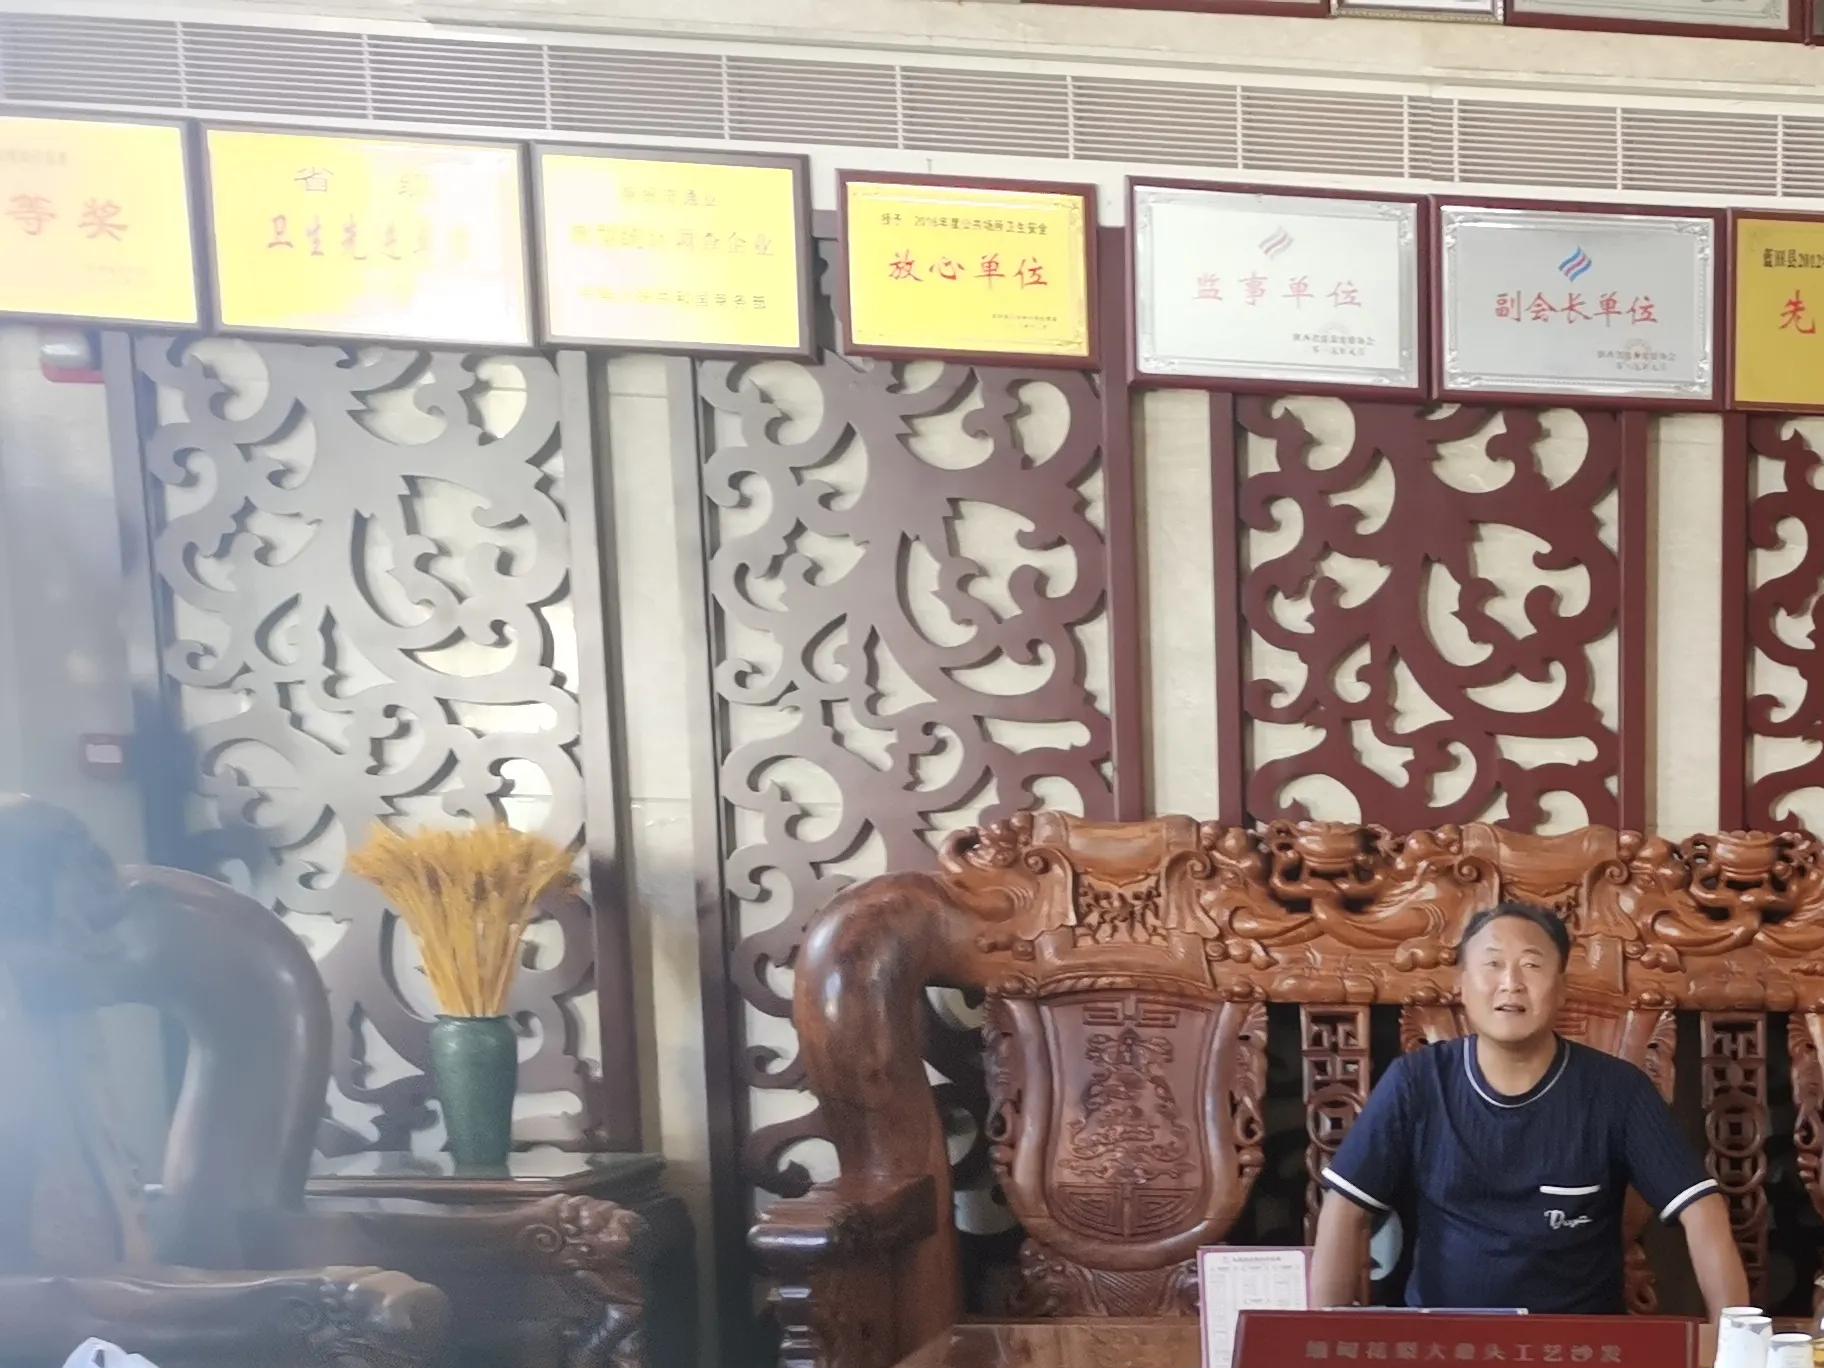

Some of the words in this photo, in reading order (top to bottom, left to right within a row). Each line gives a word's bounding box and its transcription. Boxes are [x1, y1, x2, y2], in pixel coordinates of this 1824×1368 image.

[887, 247, 1050, 291] 放心单位
[1192, 269, 1363, 310] 监事单位
[1493, 288, 1659, 327] 副会长单位
